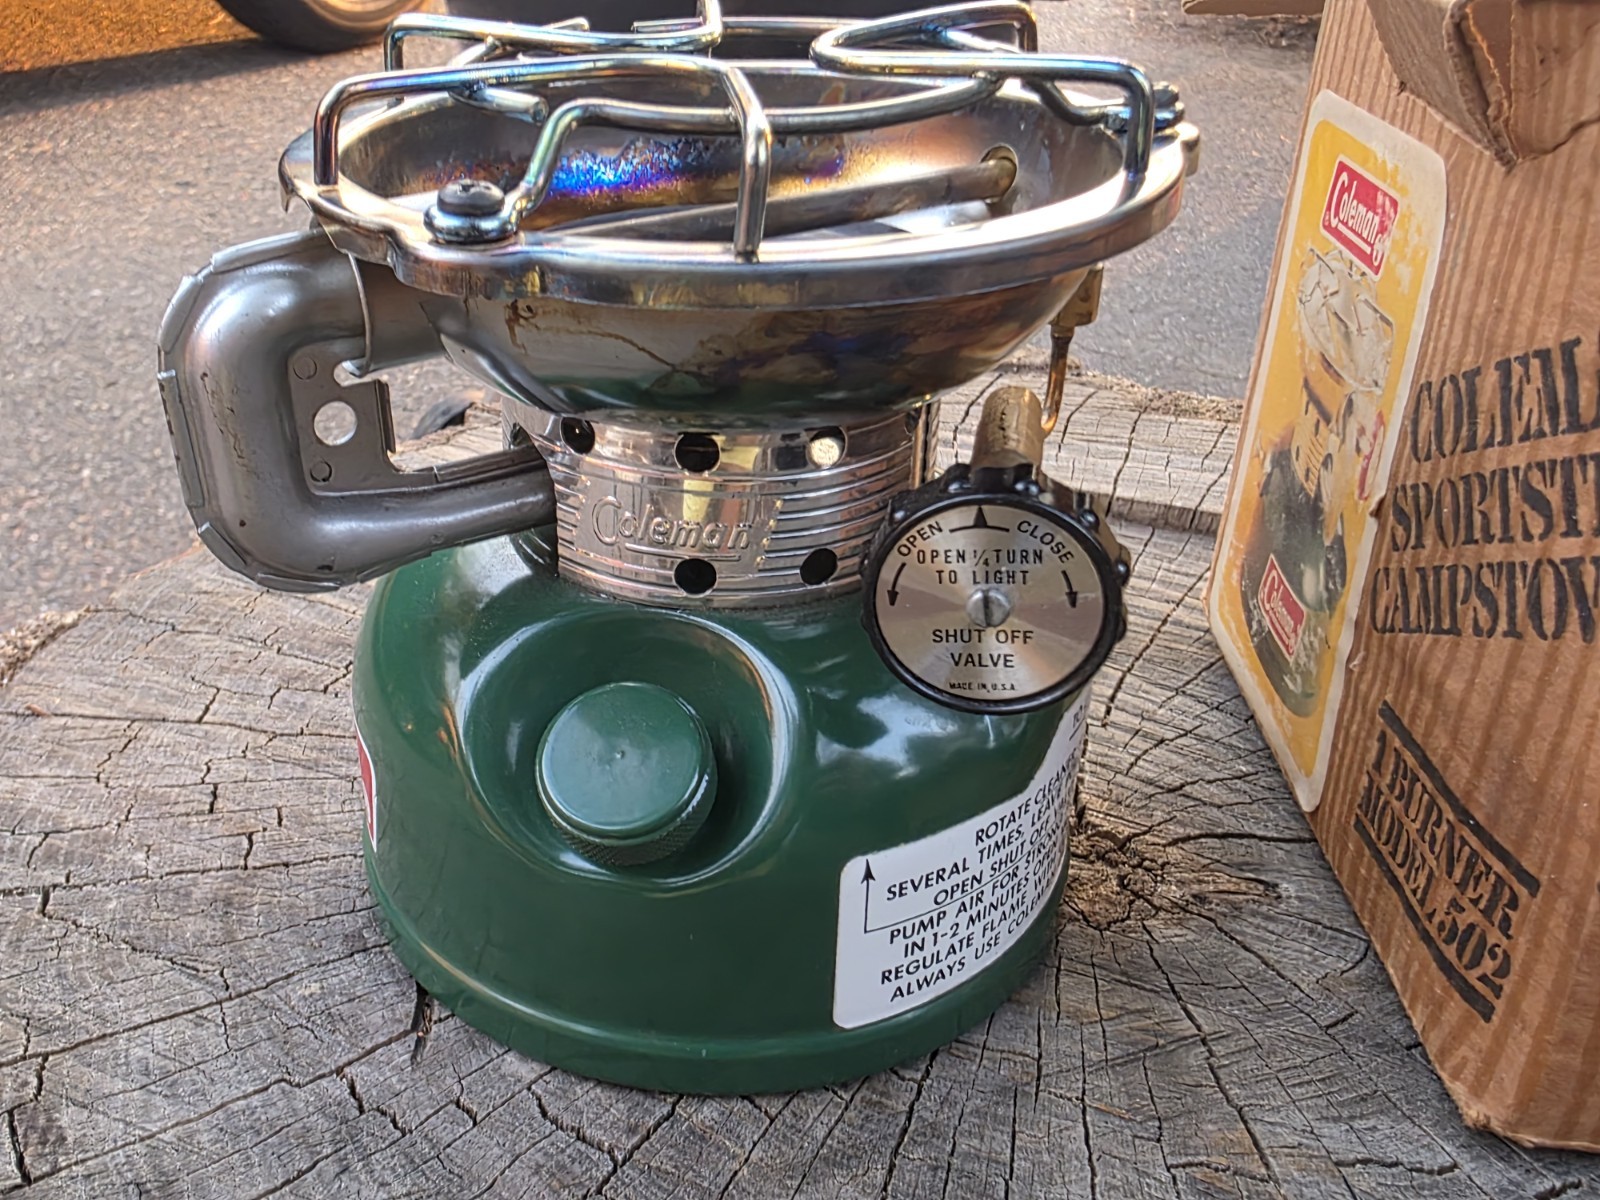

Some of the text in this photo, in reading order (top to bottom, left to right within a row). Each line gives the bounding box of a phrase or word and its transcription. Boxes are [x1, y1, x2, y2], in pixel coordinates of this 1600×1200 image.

[1331, 172, 1380, 244] Coleman
[1410, 336, 1600, 463] COLEM
[592, 495, 752, 549] Coleman
[896, 520, 1074, 564] OPEN CLOSE
[916, 549, 966, 564] OPEN
[994, 549, 1043, 564] TURN
[935, 570, 1030, 585] TO LIGHT
[932, 629, 1034, 644] SHUT OFF
[950, 653, 1015, 668] VALVE
[949, 682, 973, 690] MADE
[977, 682, 987, 690] IN
[975, 798, 1031, 847] ROTATE
[1386, 746, 1519, 940] BURNER
[886, 857, 970, 902] SEVERAL
[933, 870, 983, 907] OPEN
[989, 839, 1027, 878] SHUT
[1357, 770, 1512, 1000] MODEL 502
[889, 909, 947, 945] PUMP
[956, 890, 986, 919] AIR
[991, 865, 1020, 897] FOR
[904, 938, 926, 958] IN
[932, 923, 960, 948] 1-2
[966, 872, 1030, 930] MINUTES
[881, 934, 975, 985] REGULATE
[982, 889, 1028, 939] FLAME
[890, 957, 966, 1002] ALWAYS
[974, 931, 1001, 960] USE
